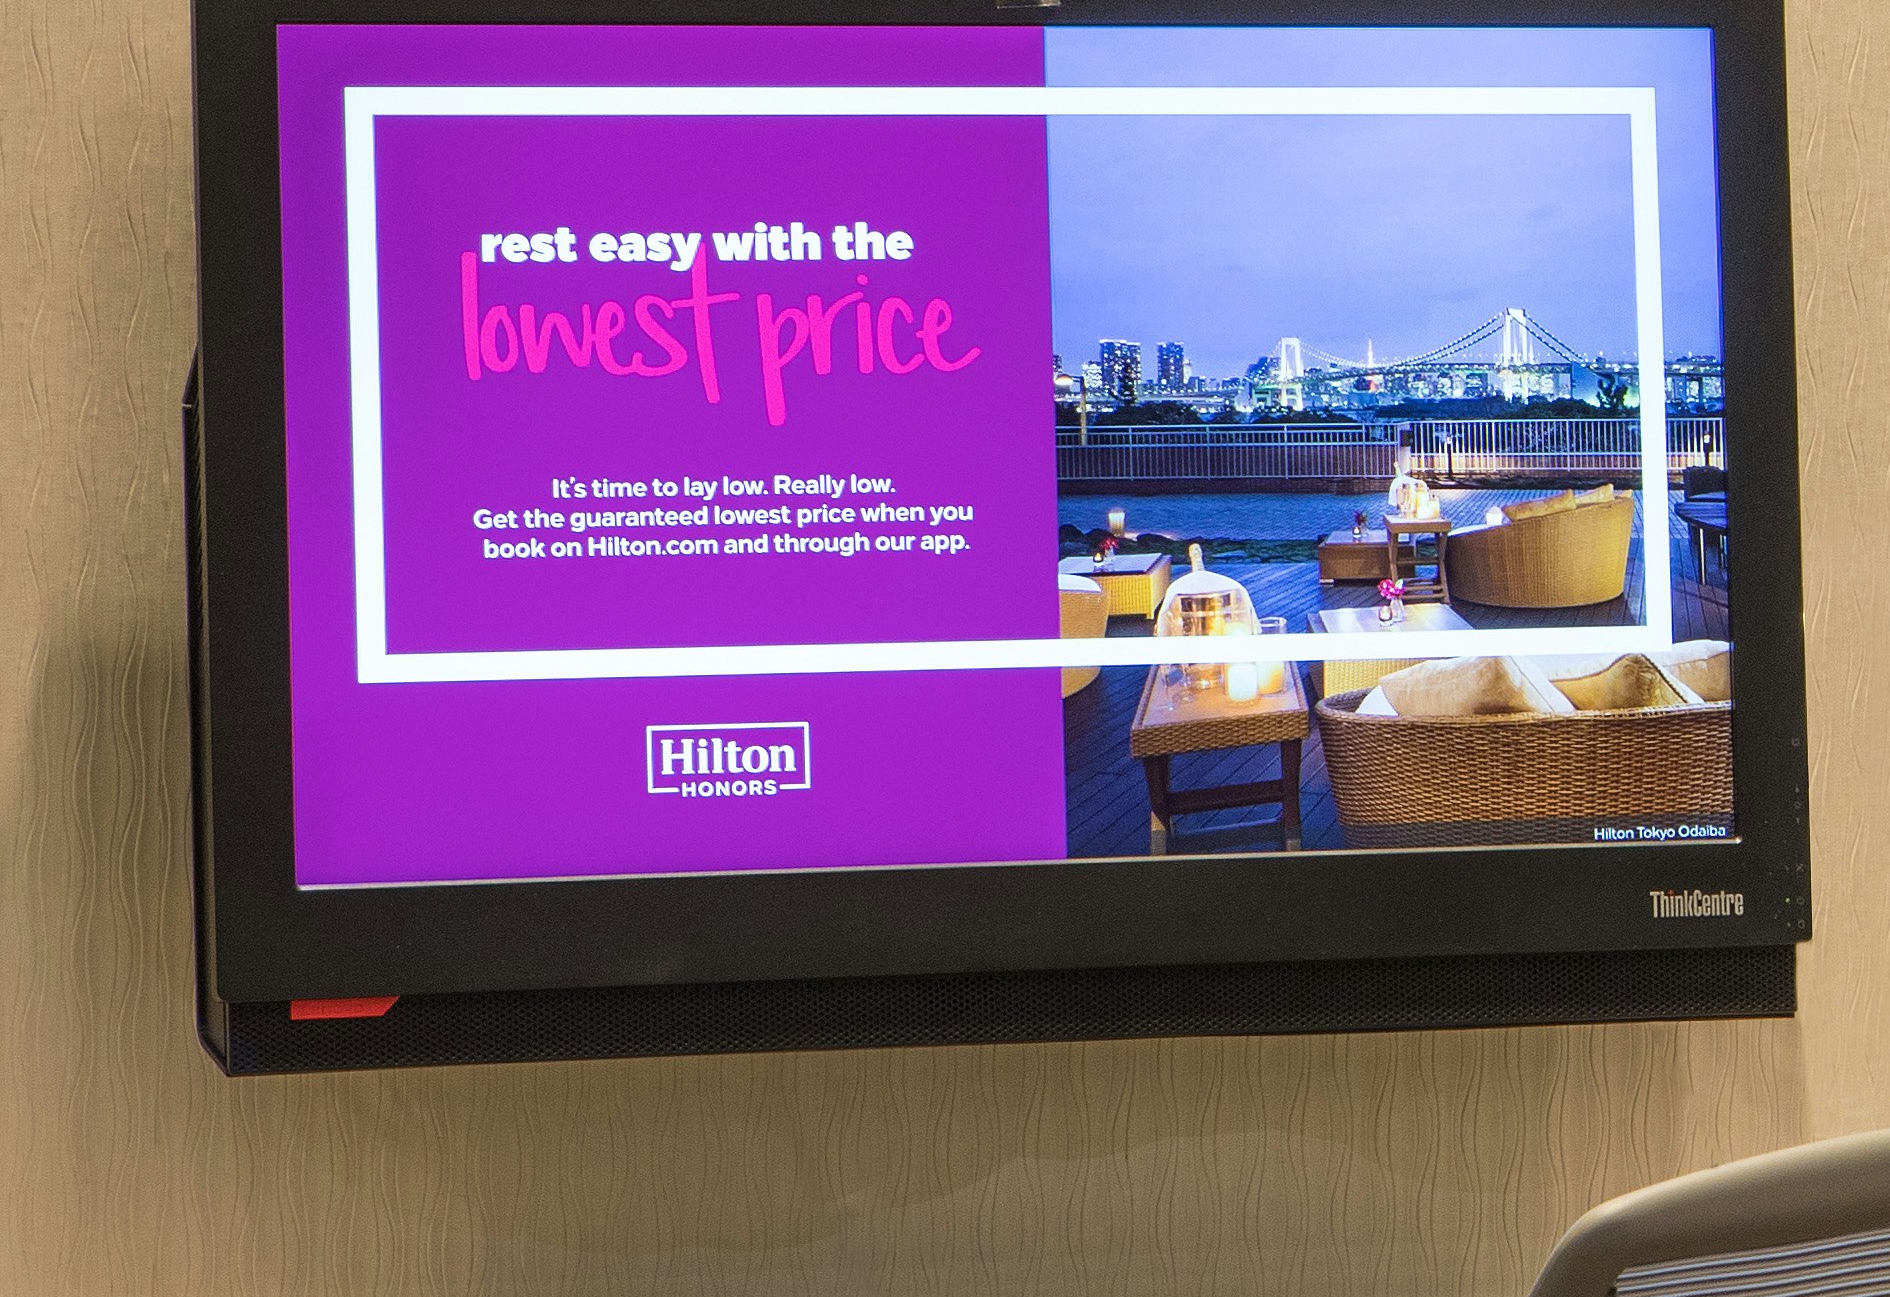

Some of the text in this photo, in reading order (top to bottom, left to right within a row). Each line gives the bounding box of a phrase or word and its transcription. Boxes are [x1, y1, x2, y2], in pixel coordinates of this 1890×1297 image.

[482, 222, 914, 271] rest easy with the
[461, 242, 982, 426] lowest price
[553, 474, 895, 500] It's time to lay low. Really low.
[473, 503, 973, 532] Get the guaranteed lowest price when you
[484, 532, 970, 558] book on Hilton.com and through our app.
[661, 738, 796, 775] Hilton
[682, 780, 776, 797] HONORS
[1594, 825, 1726, 841] Hilton Tokyo Odaiba
[1650, 890, 1744, 918] ThinkCentre
